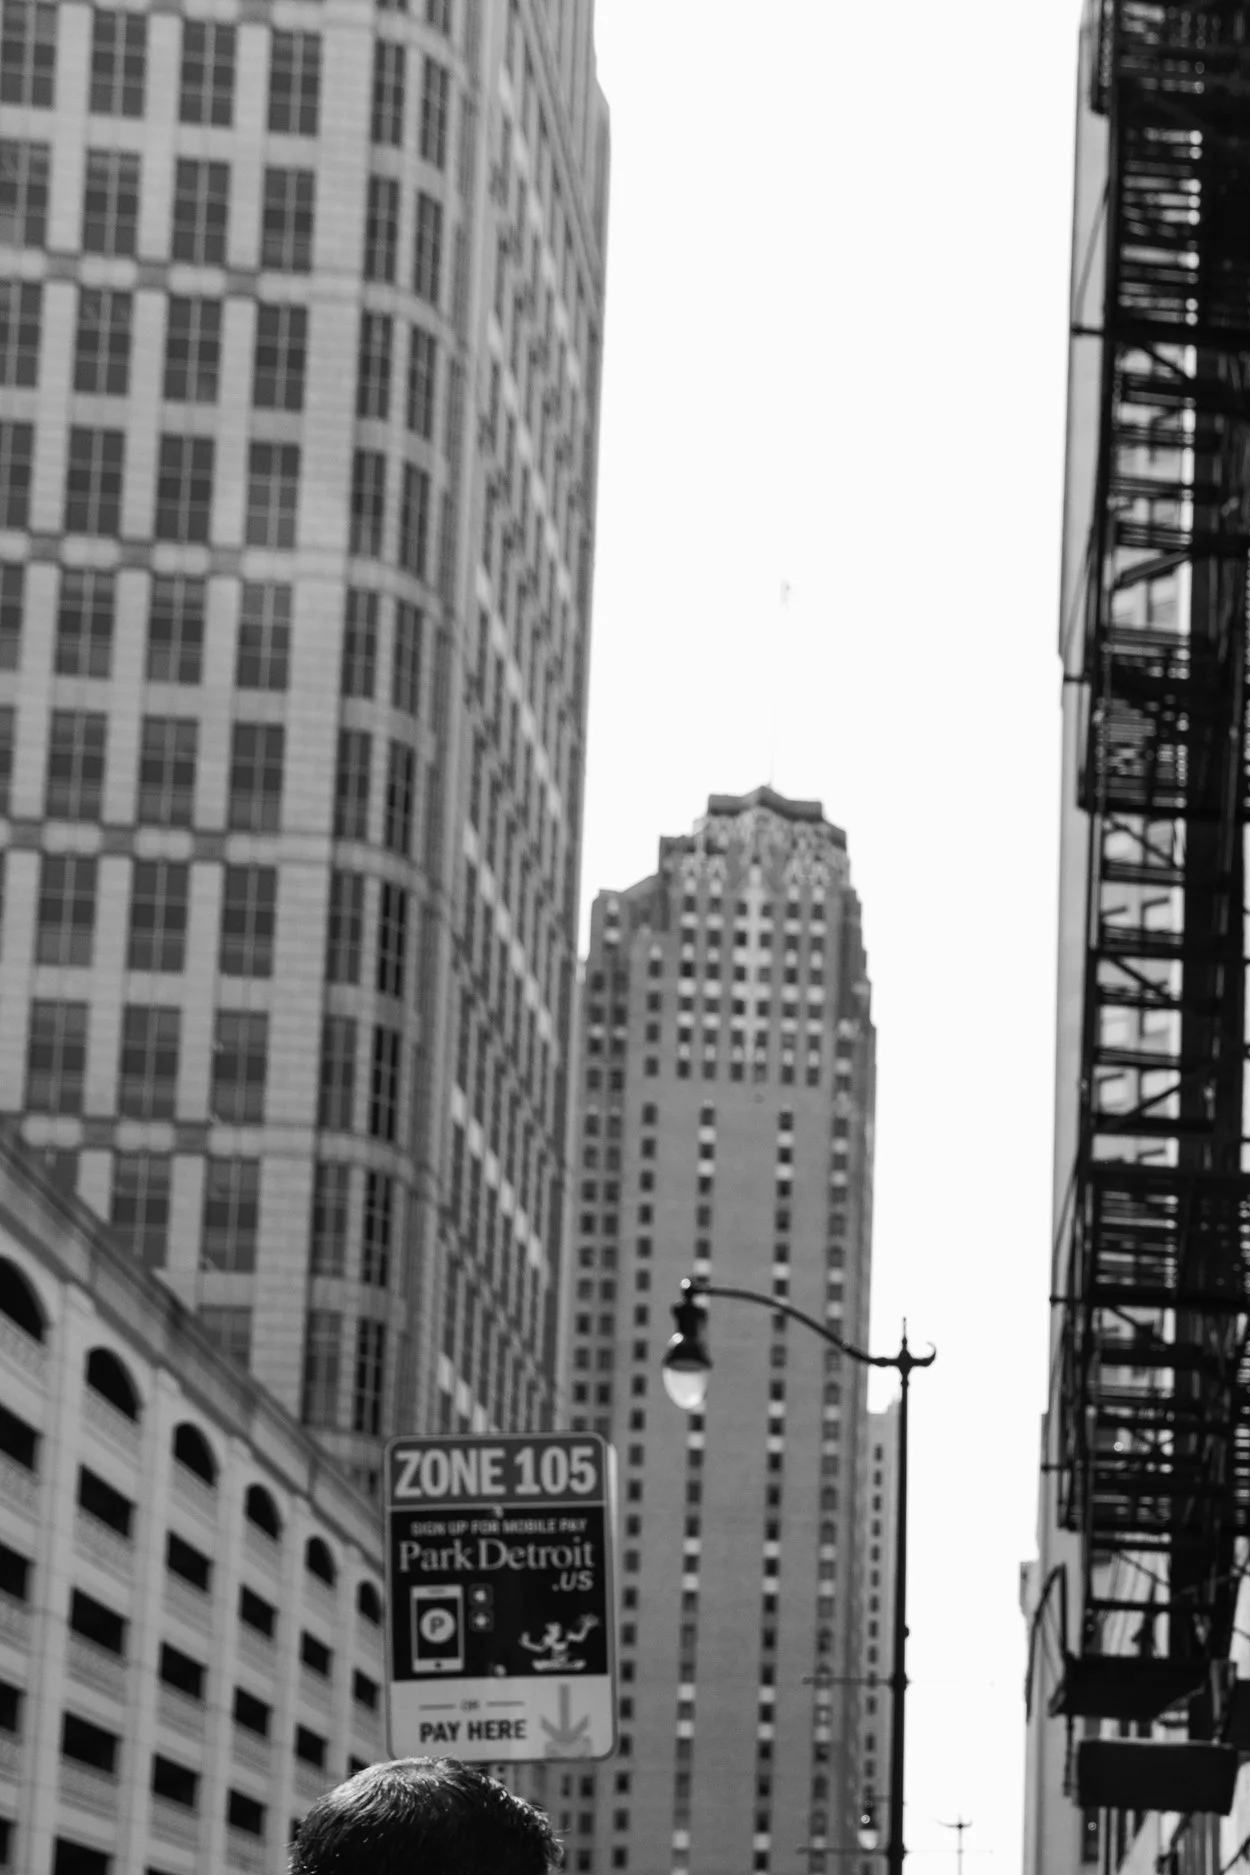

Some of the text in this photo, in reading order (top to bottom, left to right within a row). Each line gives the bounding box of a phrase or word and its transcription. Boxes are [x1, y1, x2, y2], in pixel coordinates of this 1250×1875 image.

[394, 1446, 597, 1498] ZONE 105
[411, 1517, 588, 1536] SIGN UP FOR MOBILE PAY
[552, 1570, 594, 1591] .US
[430, 1615, 445, 1634] P
[419, 1719, 527, 1742] PAY HERE
